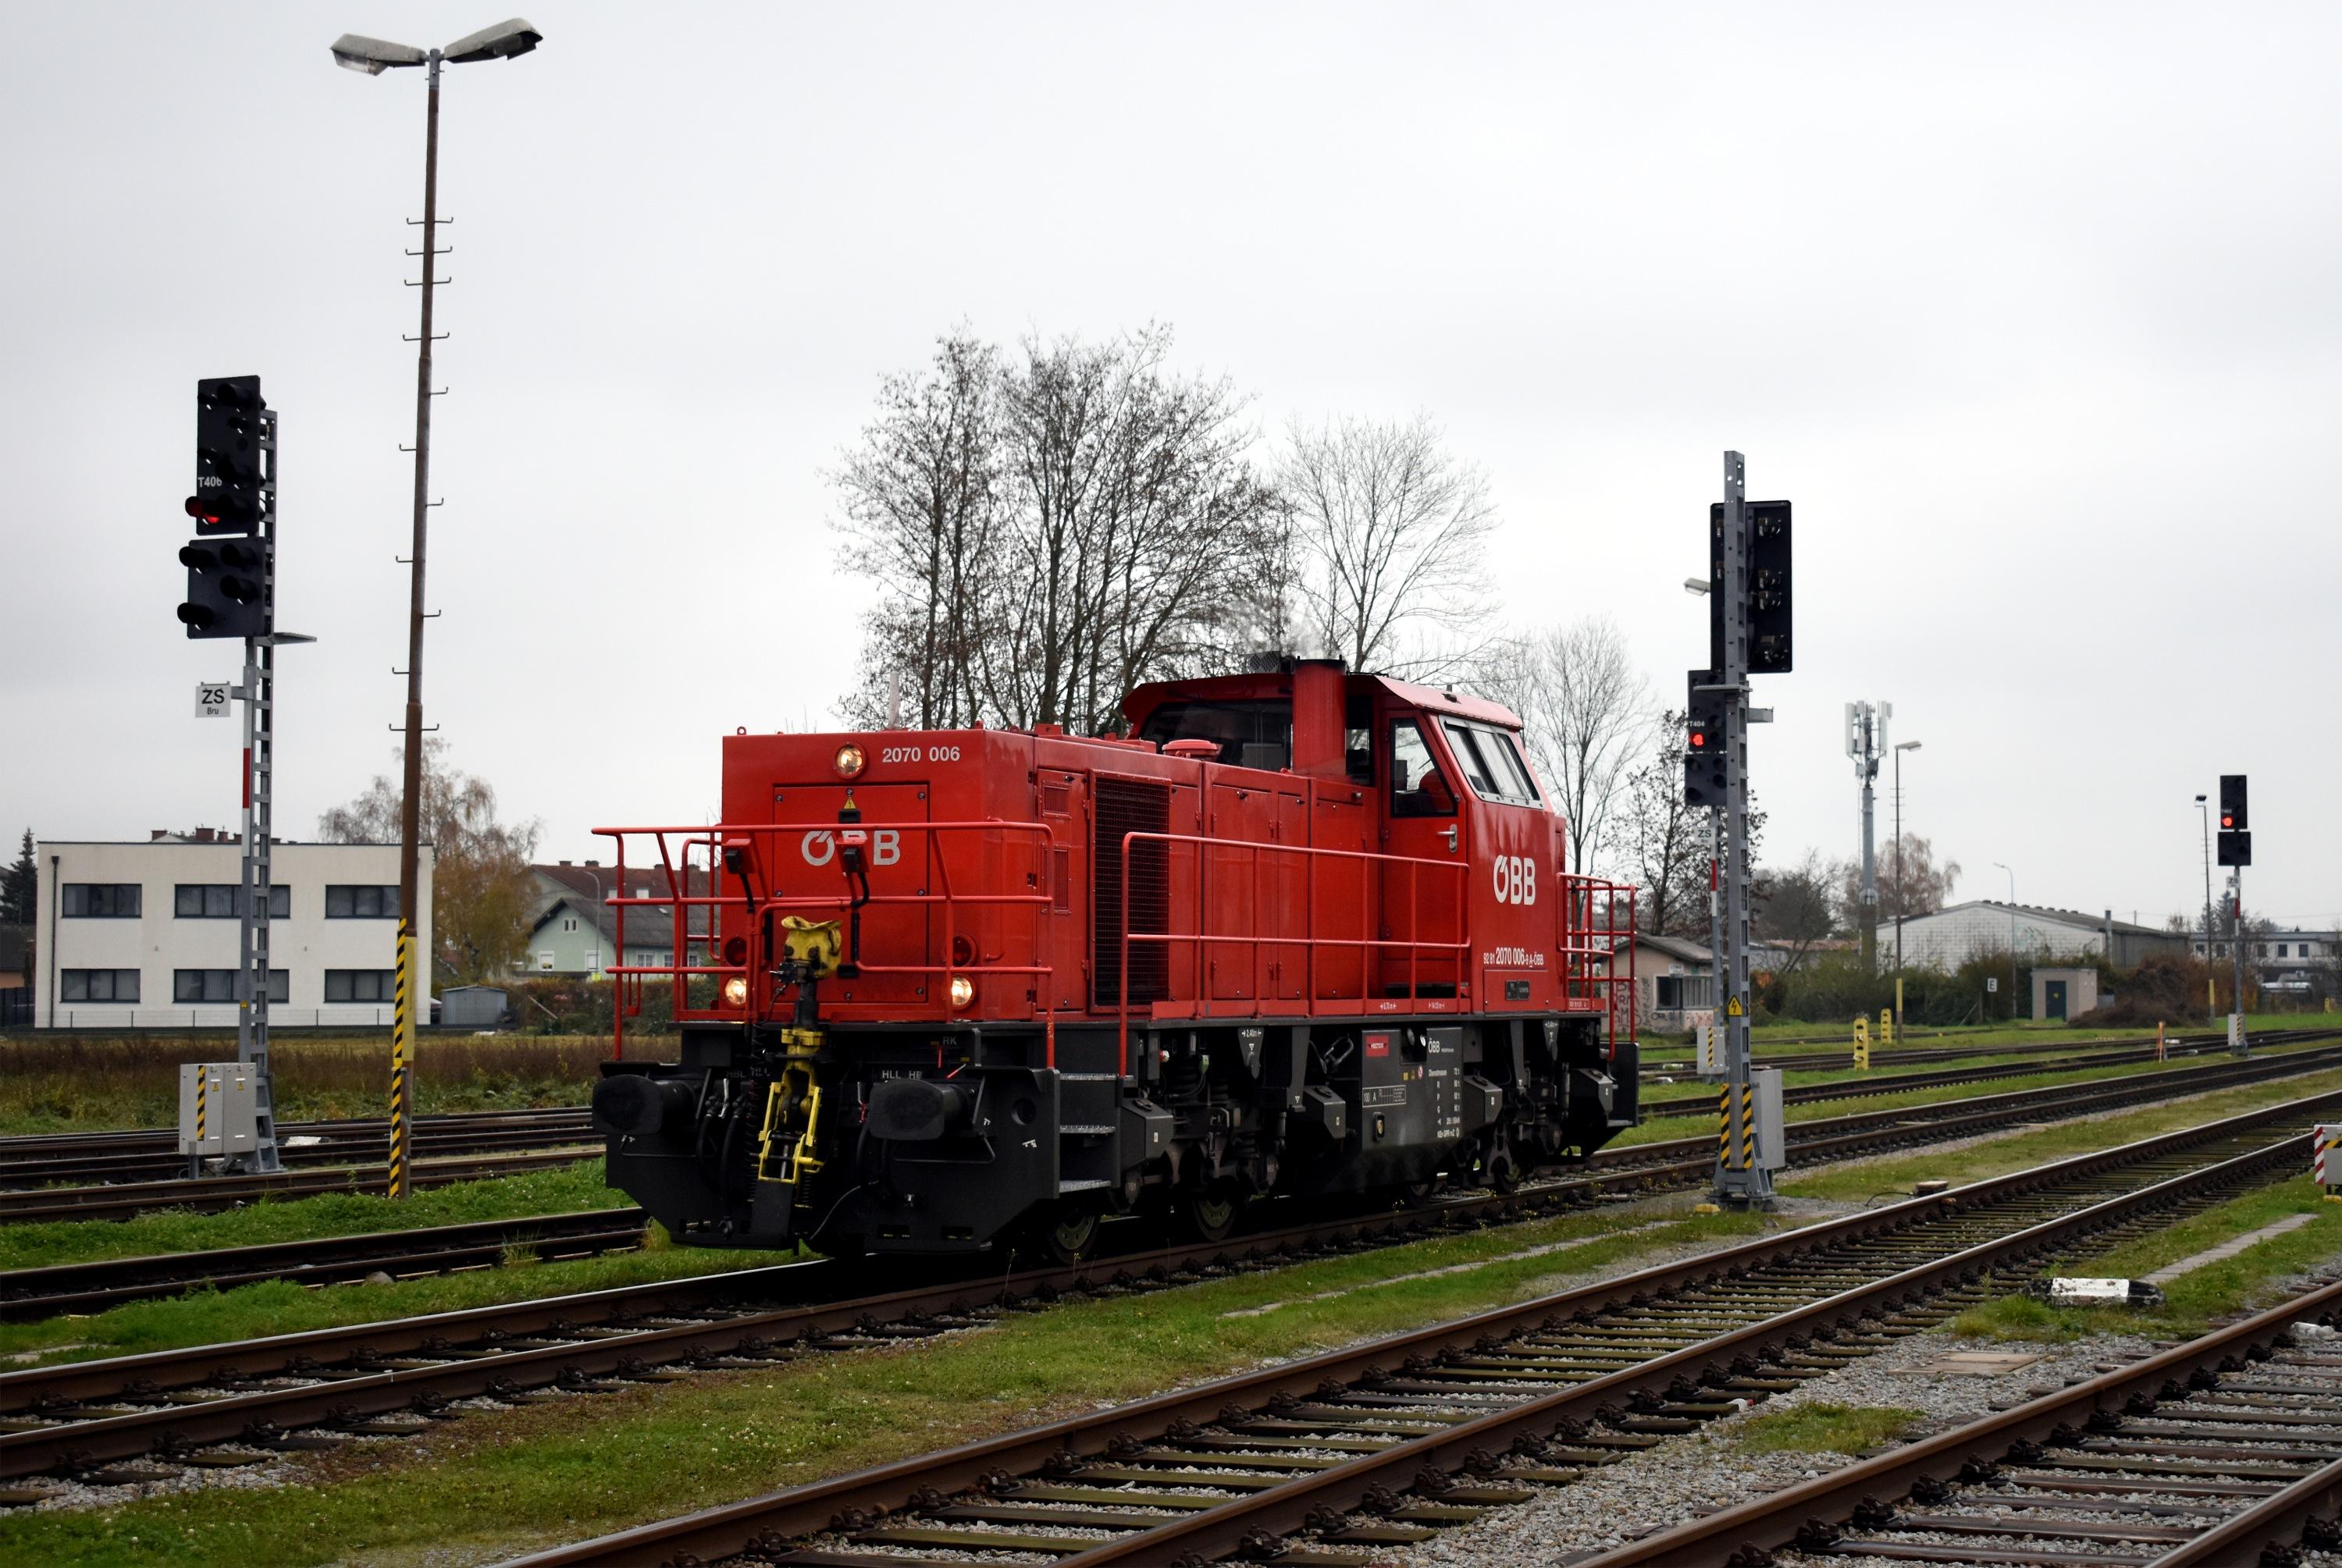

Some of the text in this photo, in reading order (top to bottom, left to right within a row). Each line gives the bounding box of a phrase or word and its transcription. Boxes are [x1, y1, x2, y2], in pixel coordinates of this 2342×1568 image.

[201, 688, 225, 704] ZS
[207, 706, 219, 715] Bru
[882, 746, 960, 763] 2070 006
[1698, 829, 1711, 837] ZS
[1493, 854, 1536, 905] ÖBB
[1483, 952, 1490, 965] 92
[1496, 947, 1512, 965] 2070
[1428, 1037, 1440, 1054] ÖBB
[881, 1070, 902, 1079] HLL
